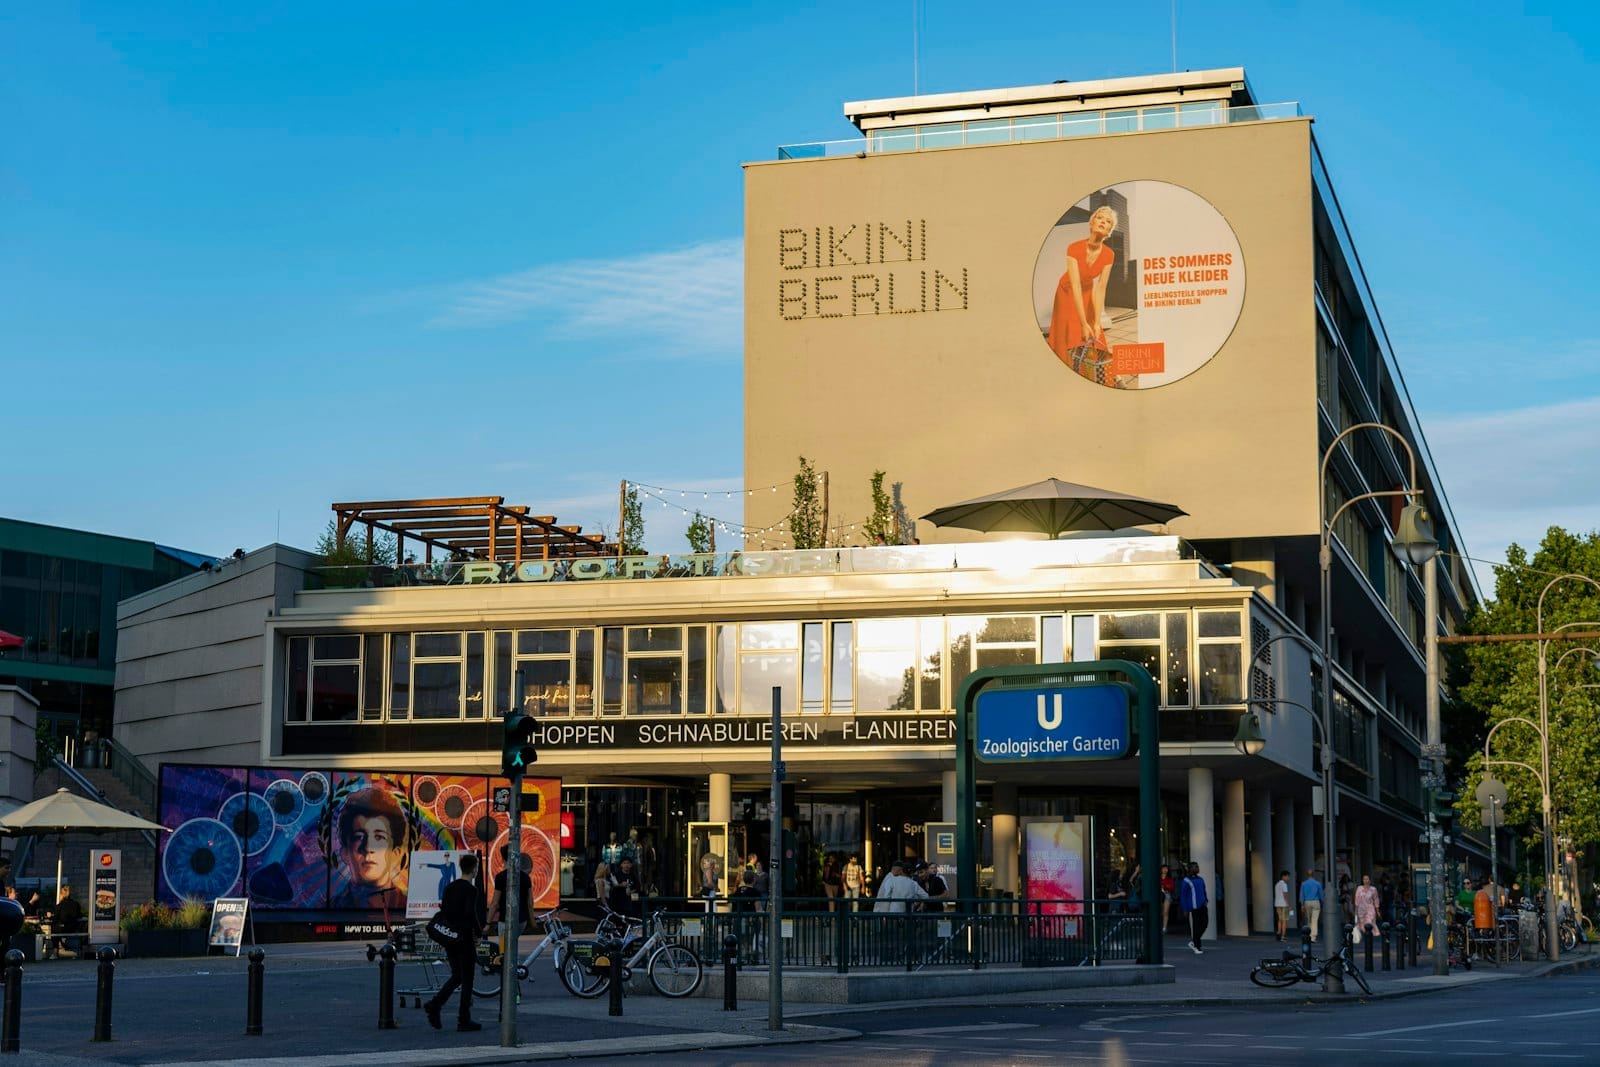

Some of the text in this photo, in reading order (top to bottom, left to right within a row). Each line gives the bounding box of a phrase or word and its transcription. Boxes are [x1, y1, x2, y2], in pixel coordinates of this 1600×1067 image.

[779, 218, 926, 271] BIKINI
[1143, 253, 1233, 270] DES SOMMERS
[1143, 268, 1229, 286] NEUE KLEIDER
[779, 267, 968, 321] BERLIN
[1143, 288, 1228, 300] LIEBLINGSTEILE SHOPPEN
[1154, 299, 1176, 307] BIKINI
[1177, 298, 1201, 306] BERLIN
[1117, 347, 1151, 360] BIKINI
[1117, 358, 1161, 371] BERLIN
[1037, 693, 1063, 730] U
[527, 724, 615, 745] HOPPEN
[638, 722, 819, 743] SCHNABULIEREN
[983, 736, 1120, 757] Zoologischer Garten
[216, 903, 237, 913] OPEN
[362, 925, 372, 933] TO
[372, 925, 387, 933] SELL
